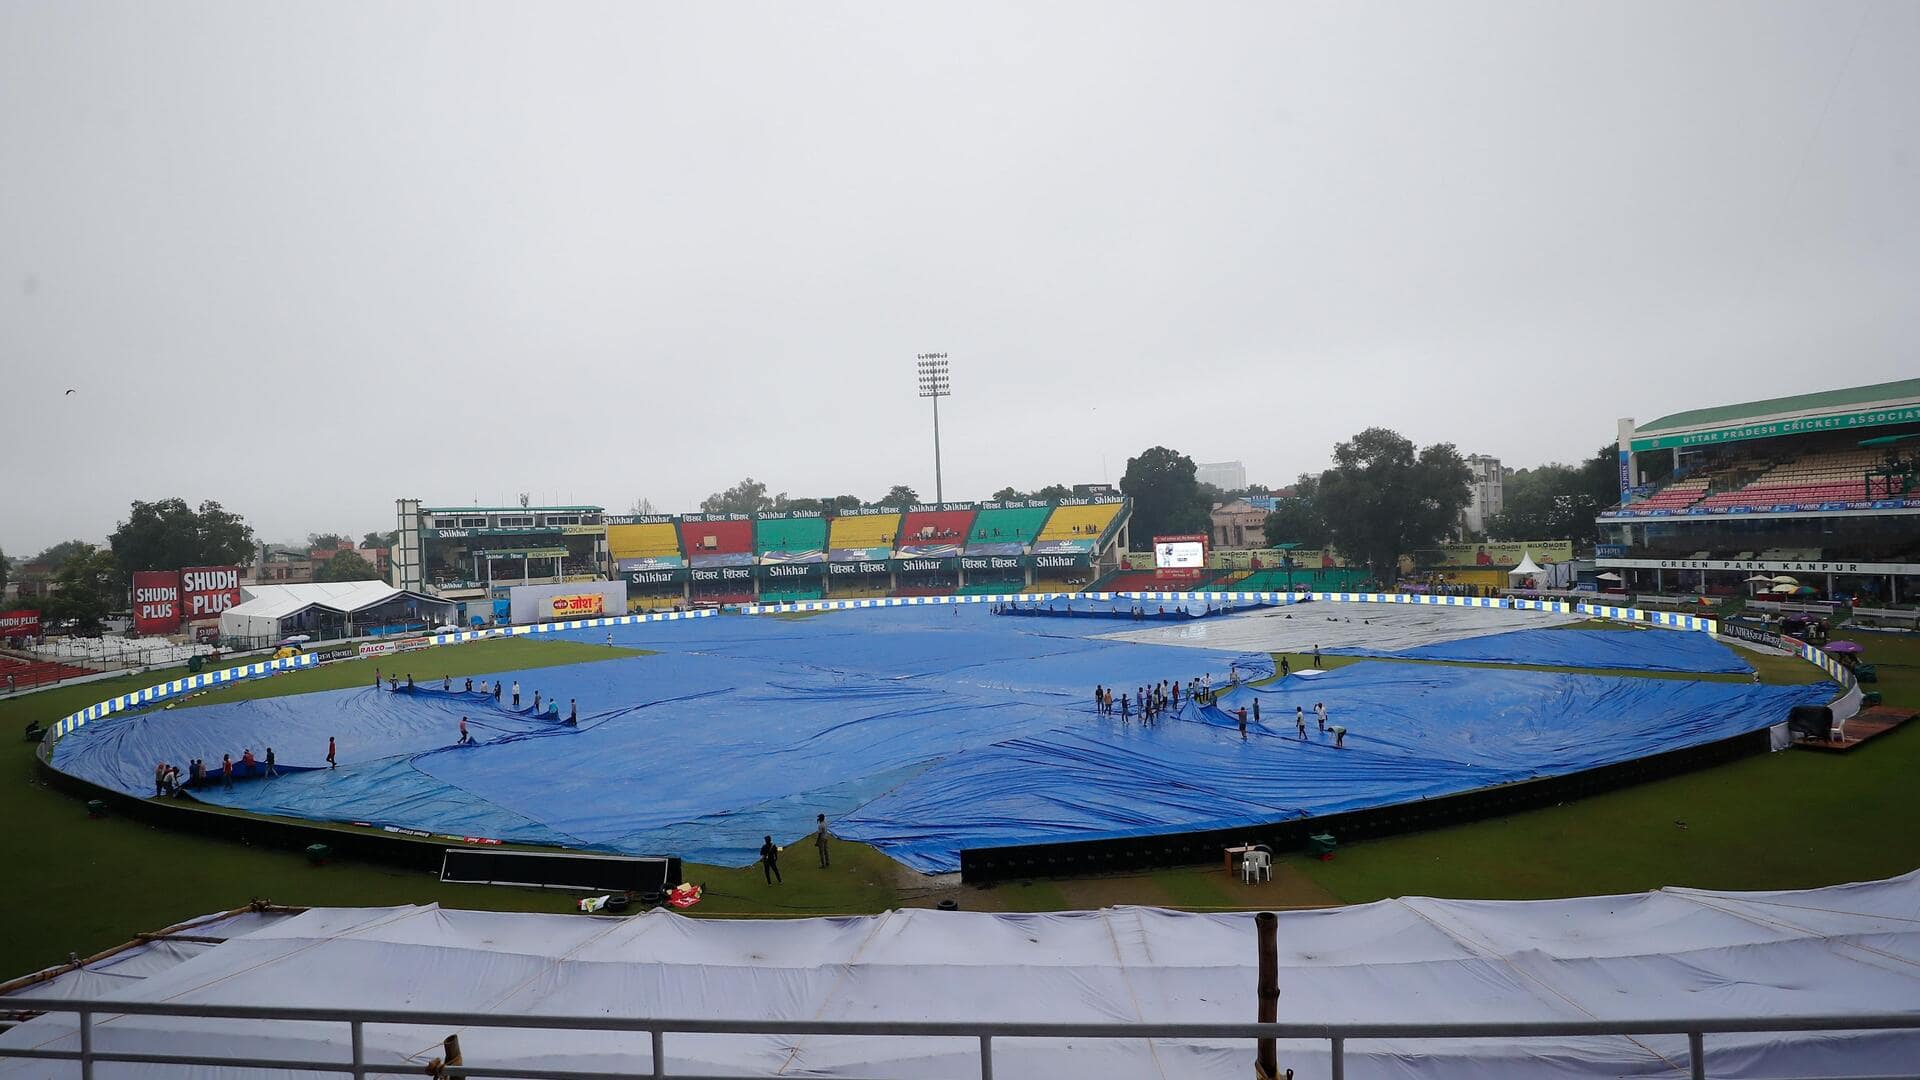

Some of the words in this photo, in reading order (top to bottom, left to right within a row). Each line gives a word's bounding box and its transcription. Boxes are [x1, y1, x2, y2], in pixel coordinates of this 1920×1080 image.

[1683, 434, 1718, 443] UTTAR
[1723, 425, 1776, 439] PRADESH
[1784, 418, 1840, 432] CRICKET
[1060, 497, 1088, 506] Shikhar
[1094, 496, 1124, 504] Shikhar
[909, 505, 937, 513] Shikhar
[943, 503, 971, 512] Shikhar
[604, 516, 633, 525] Shikhar
[640, 515, 670, 524] Shikhar
[758, 511, 787, 520] Shikhar
[793, 510, 821, 519] Shikhar
[439, 529, 469, 538] Shikhar
[829, 563, 856, 574] शिखर
[860, 562, 886, 573] शिखर
[903, 560, 941, 571] Shikhar
[962, 558, 988, 569] शिखर
[991, 557, 1018, 568] शिखर
[1037, 556, 1075, 568] Shikhar
[1724, 561, 1765, 570] PARK
[1783, 562, 1857, 572] KANPUR
[692, 569, 719, 581] शिखर
[723, 568, 749, 579] शिखर
[770, 565, 809, 577] Shikhar
[184, 571, 238, 592] SHUDH
[633, 572, 672, 583] Shikhar
[137, 587, 177, 603] SHUDH
[193, 594, 232, 615] PLUS
[569, 596, 592, 609] जोश
[143, 603, 172, 619] PLUS
[20, 616, 38, 625] PLUS
[360, 645, 385, 653] RALCO
